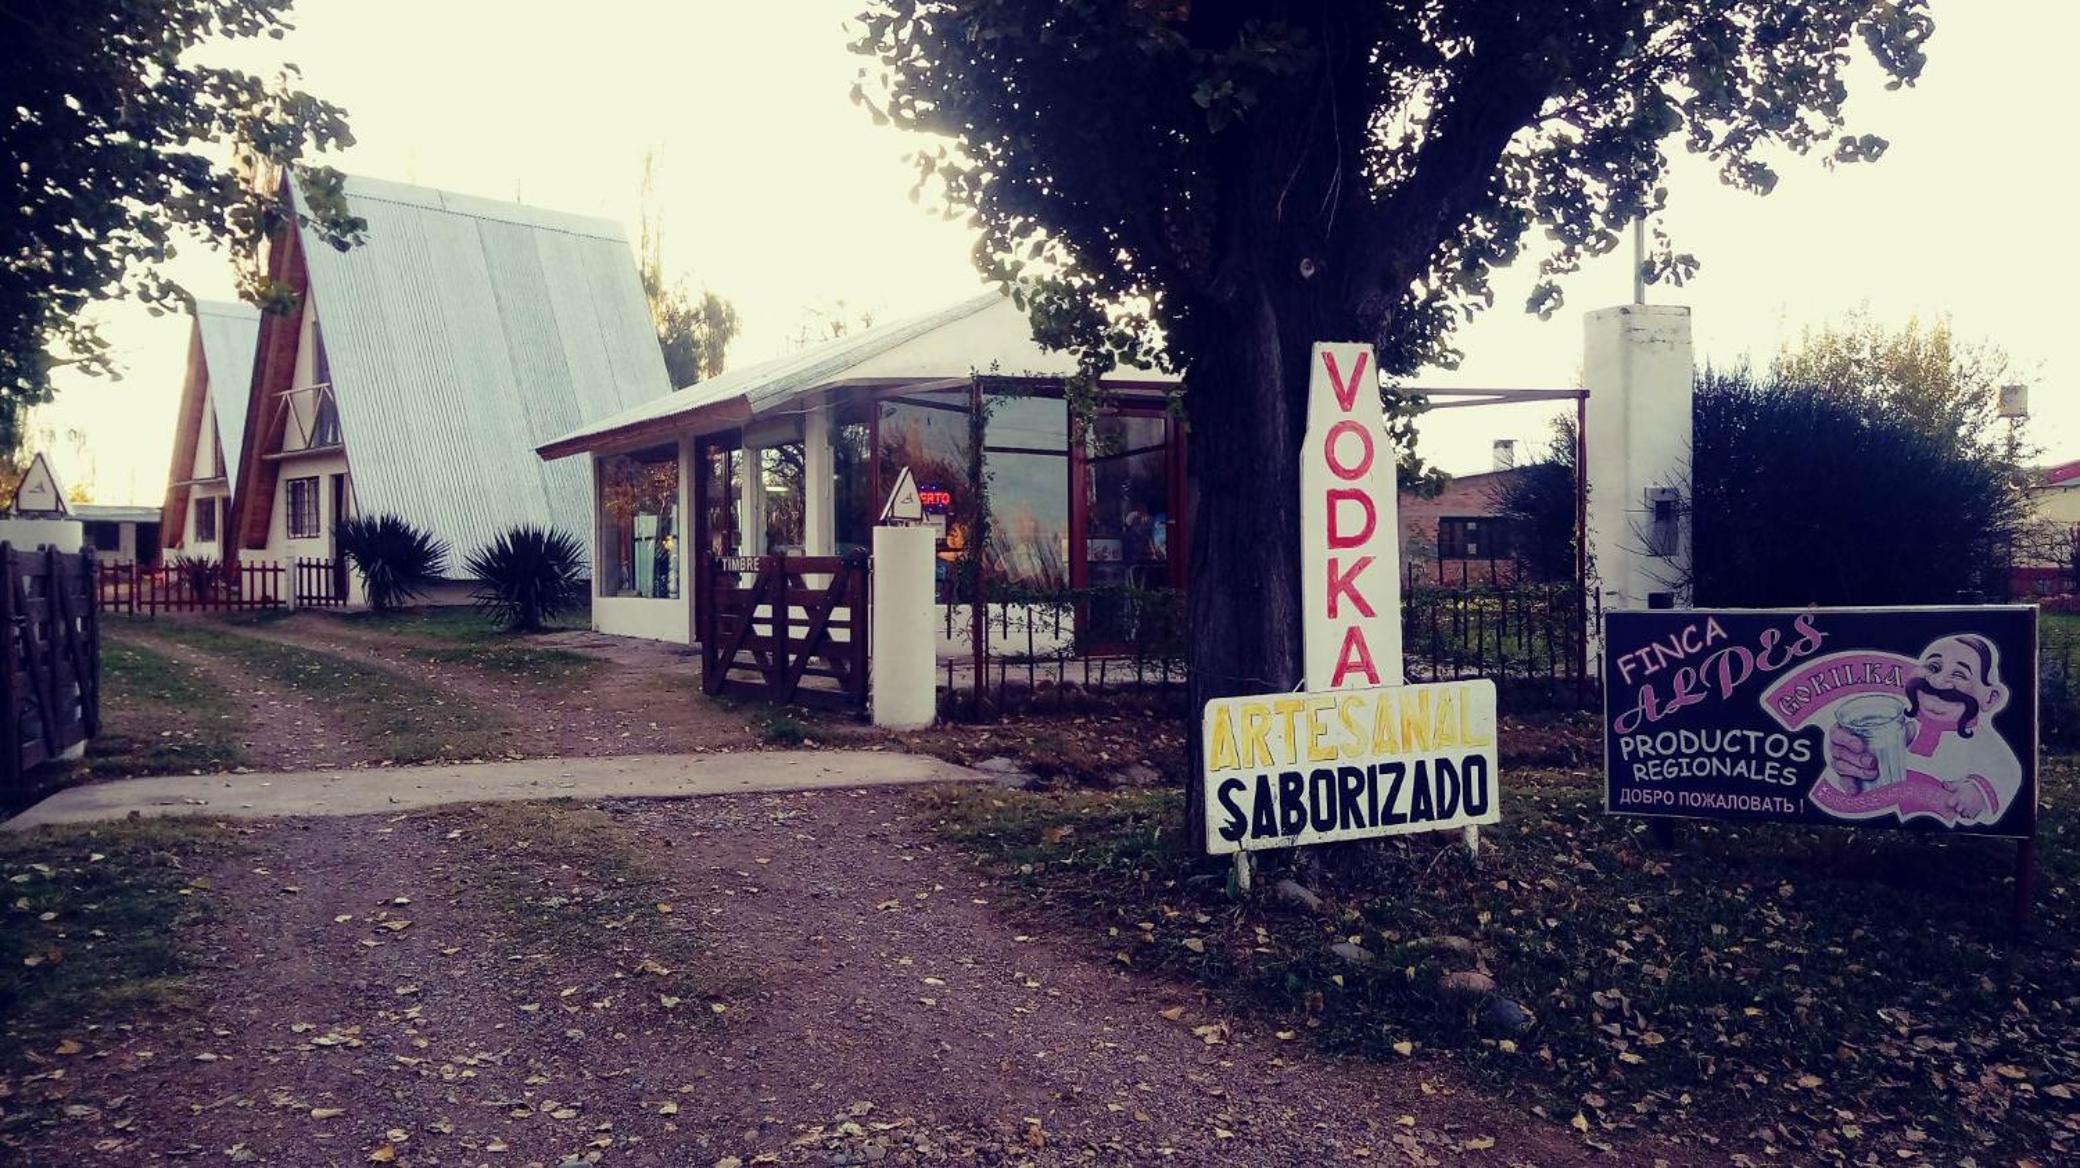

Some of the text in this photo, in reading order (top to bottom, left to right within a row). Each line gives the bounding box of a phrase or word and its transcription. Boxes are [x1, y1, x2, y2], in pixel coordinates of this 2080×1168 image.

[1321, 351, 1381, 688] VODKA
[722, 557, 760, 572] TIMBRE
[1616, 616, 1728, 685] FINCA
[1777, 662, 1905, 717] GORILKA
[1209, 687, 1491, 772] ARTESANAL
[1619, 729, 1812, 762] PRODUCTOS
[1217, 754, 1489, 843] SABORIZADO
[1632, 756, 1798, 786] REGIONALES
[1620, 789, 1674, 805] ДОБРО
[1679, 791, 1795, 813] ПОЖАЛОВАТЬ
